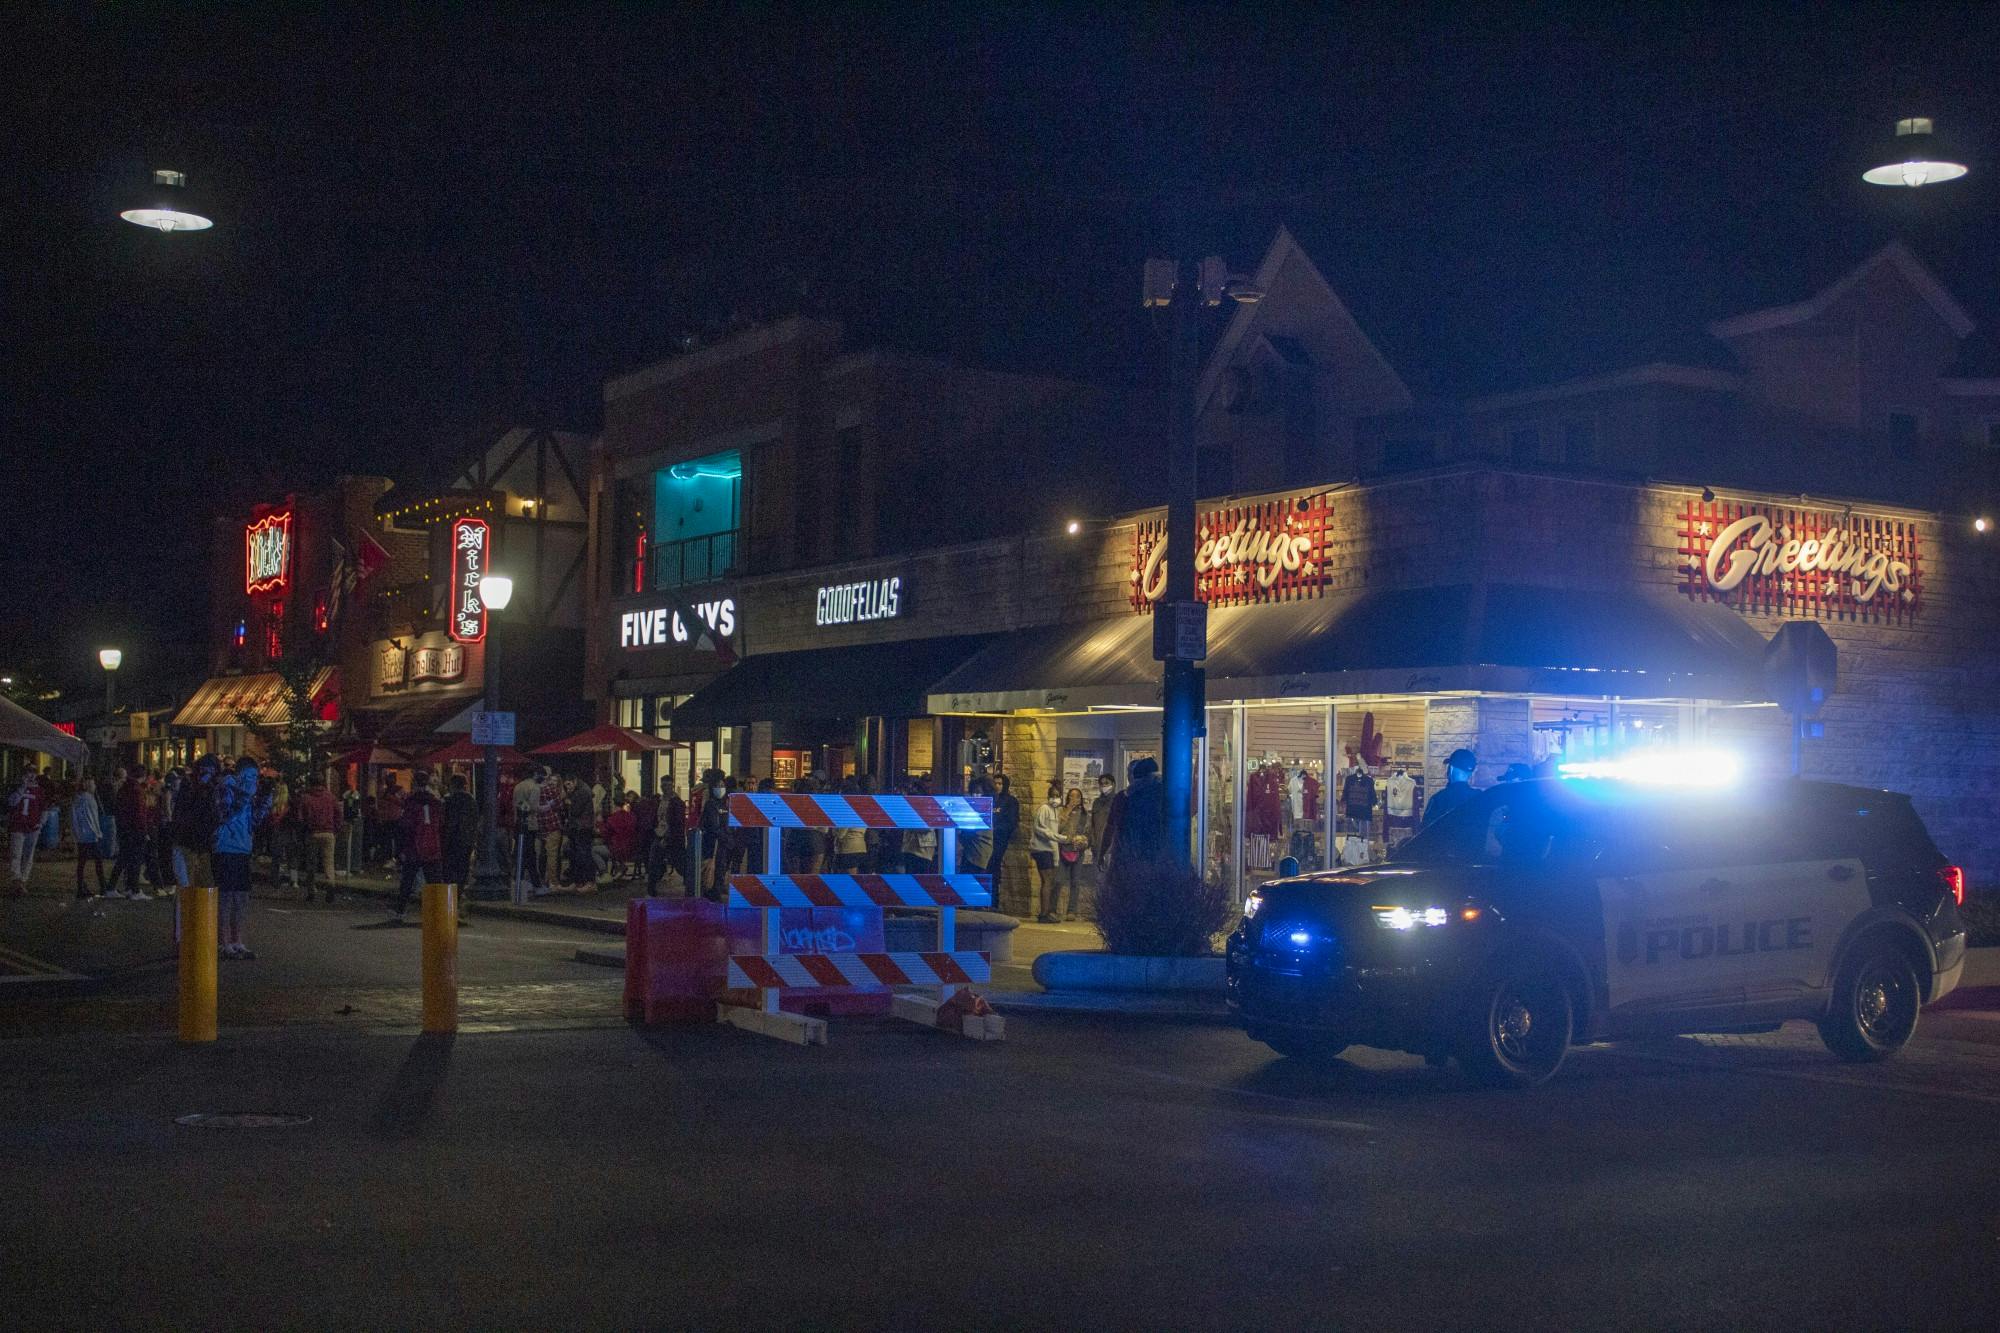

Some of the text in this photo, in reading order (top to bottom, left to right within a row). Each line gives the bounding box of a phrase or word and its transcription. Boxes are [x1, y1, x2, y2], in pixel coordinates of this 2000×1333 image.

[456, 525, 486, 636] Nick's
[1706, 515, 1910, 602] Greetings
[816, 577, 899, 626] GOODFELLAS
[621, 609, 667, 647] FIVE
[1644, 916, 1813, 964] POLICE
